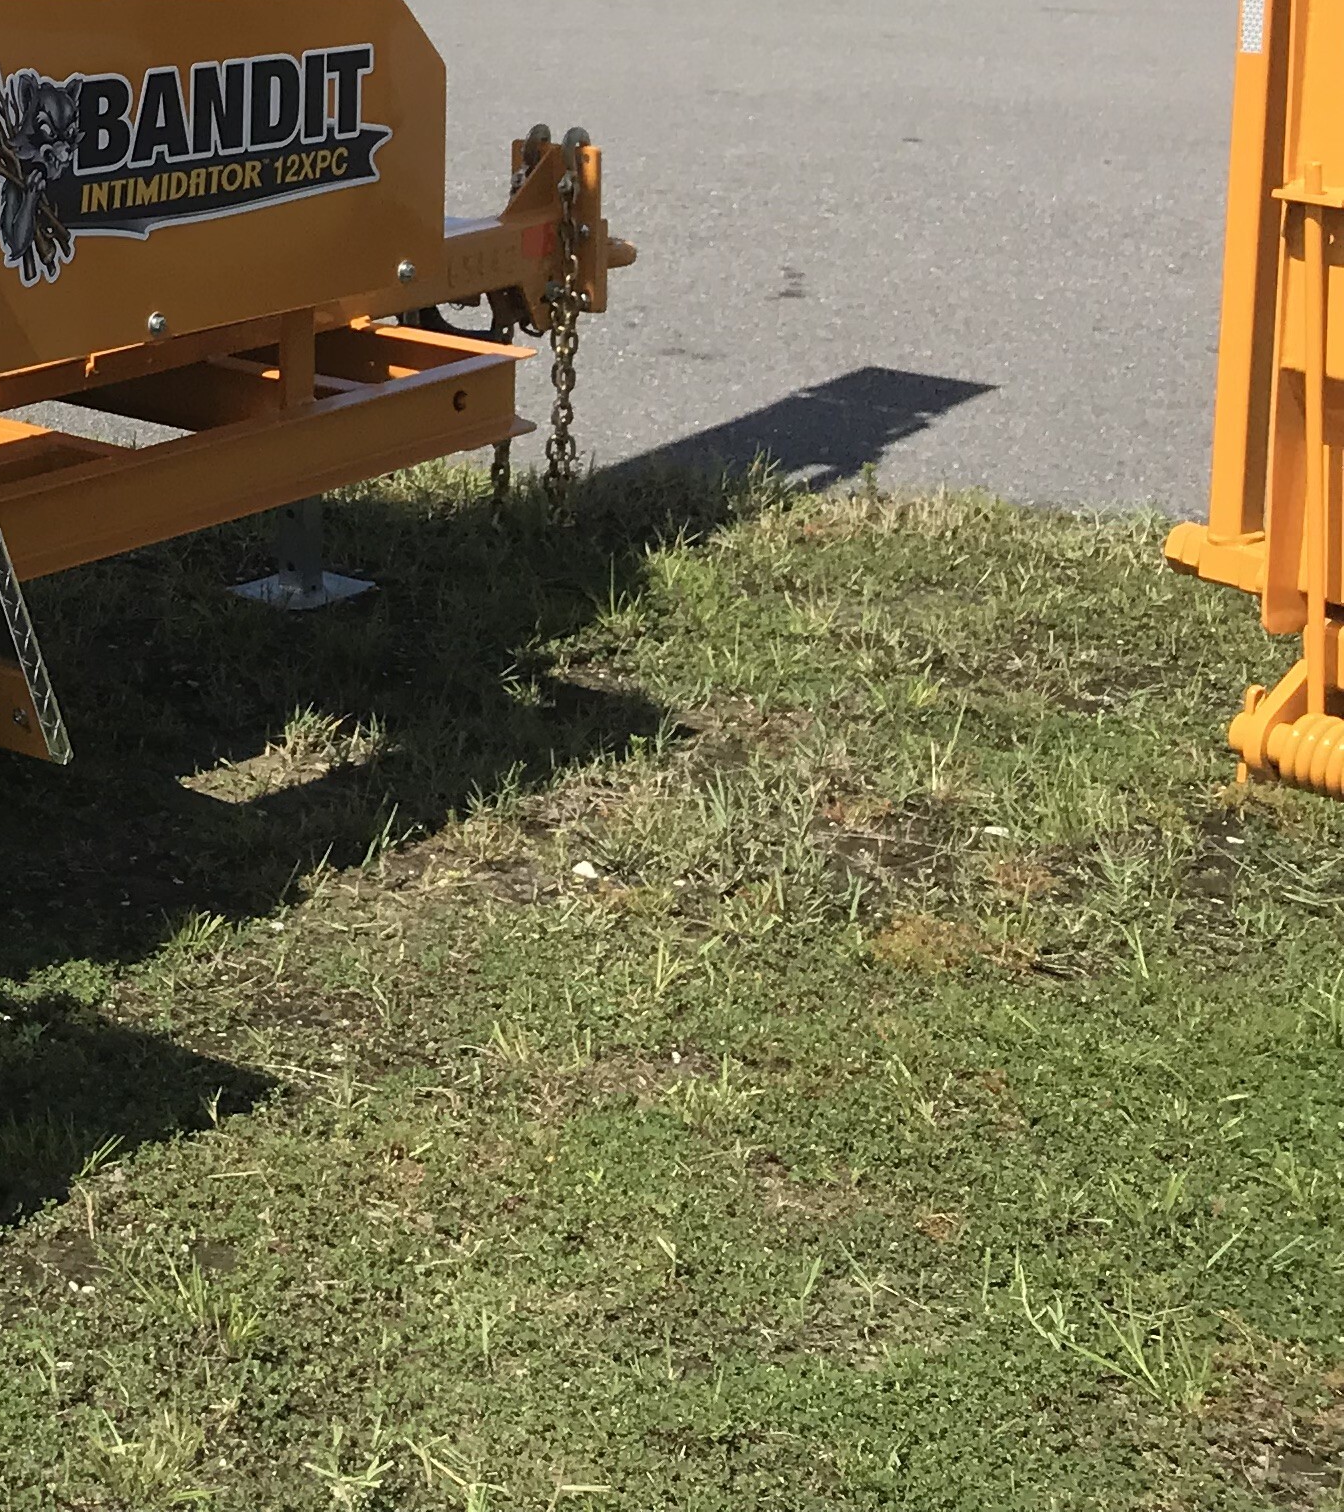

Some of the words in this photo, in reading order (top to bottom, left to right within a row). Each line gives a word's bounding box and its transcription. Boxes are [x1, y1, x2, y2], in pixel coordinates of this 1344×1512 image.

[76, 48, 372, 171] BANDIT
[80, 162, 263, 215] INTIMIDATOR
[274, 146, 349, 184] 12XPC
